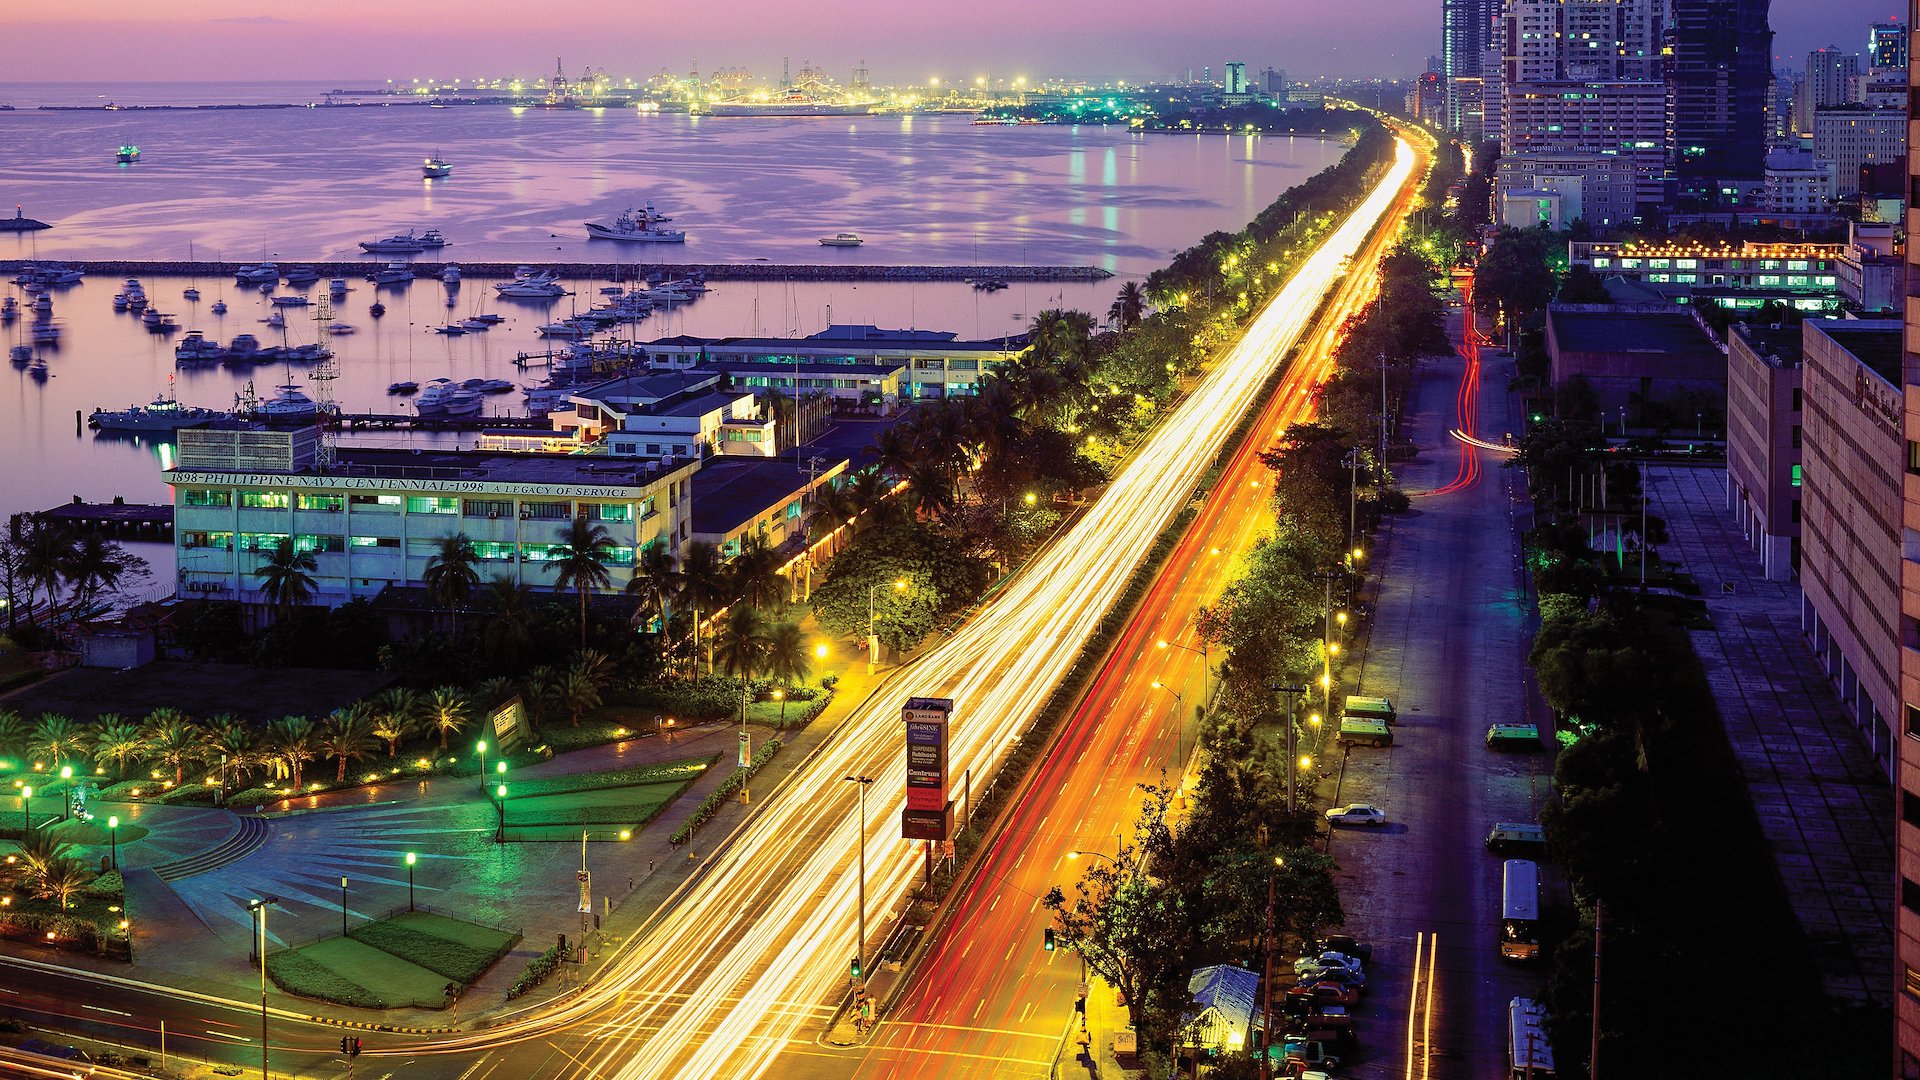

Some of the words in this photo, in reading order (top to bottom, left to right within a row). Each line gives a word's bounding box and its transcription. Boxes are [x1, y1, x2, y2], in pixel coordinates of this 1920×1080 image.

[171, 472, 295, 486] 1898-PHILIPPINE
[298, 476, 340, 487] NAVY
[345, 477, 484, 492] CENTENNIAL-1998
[505, 486, 551, 495] LEGACY
[555, 487, 572, 495] OF
[575, 487, 628, 497] SERVICE
